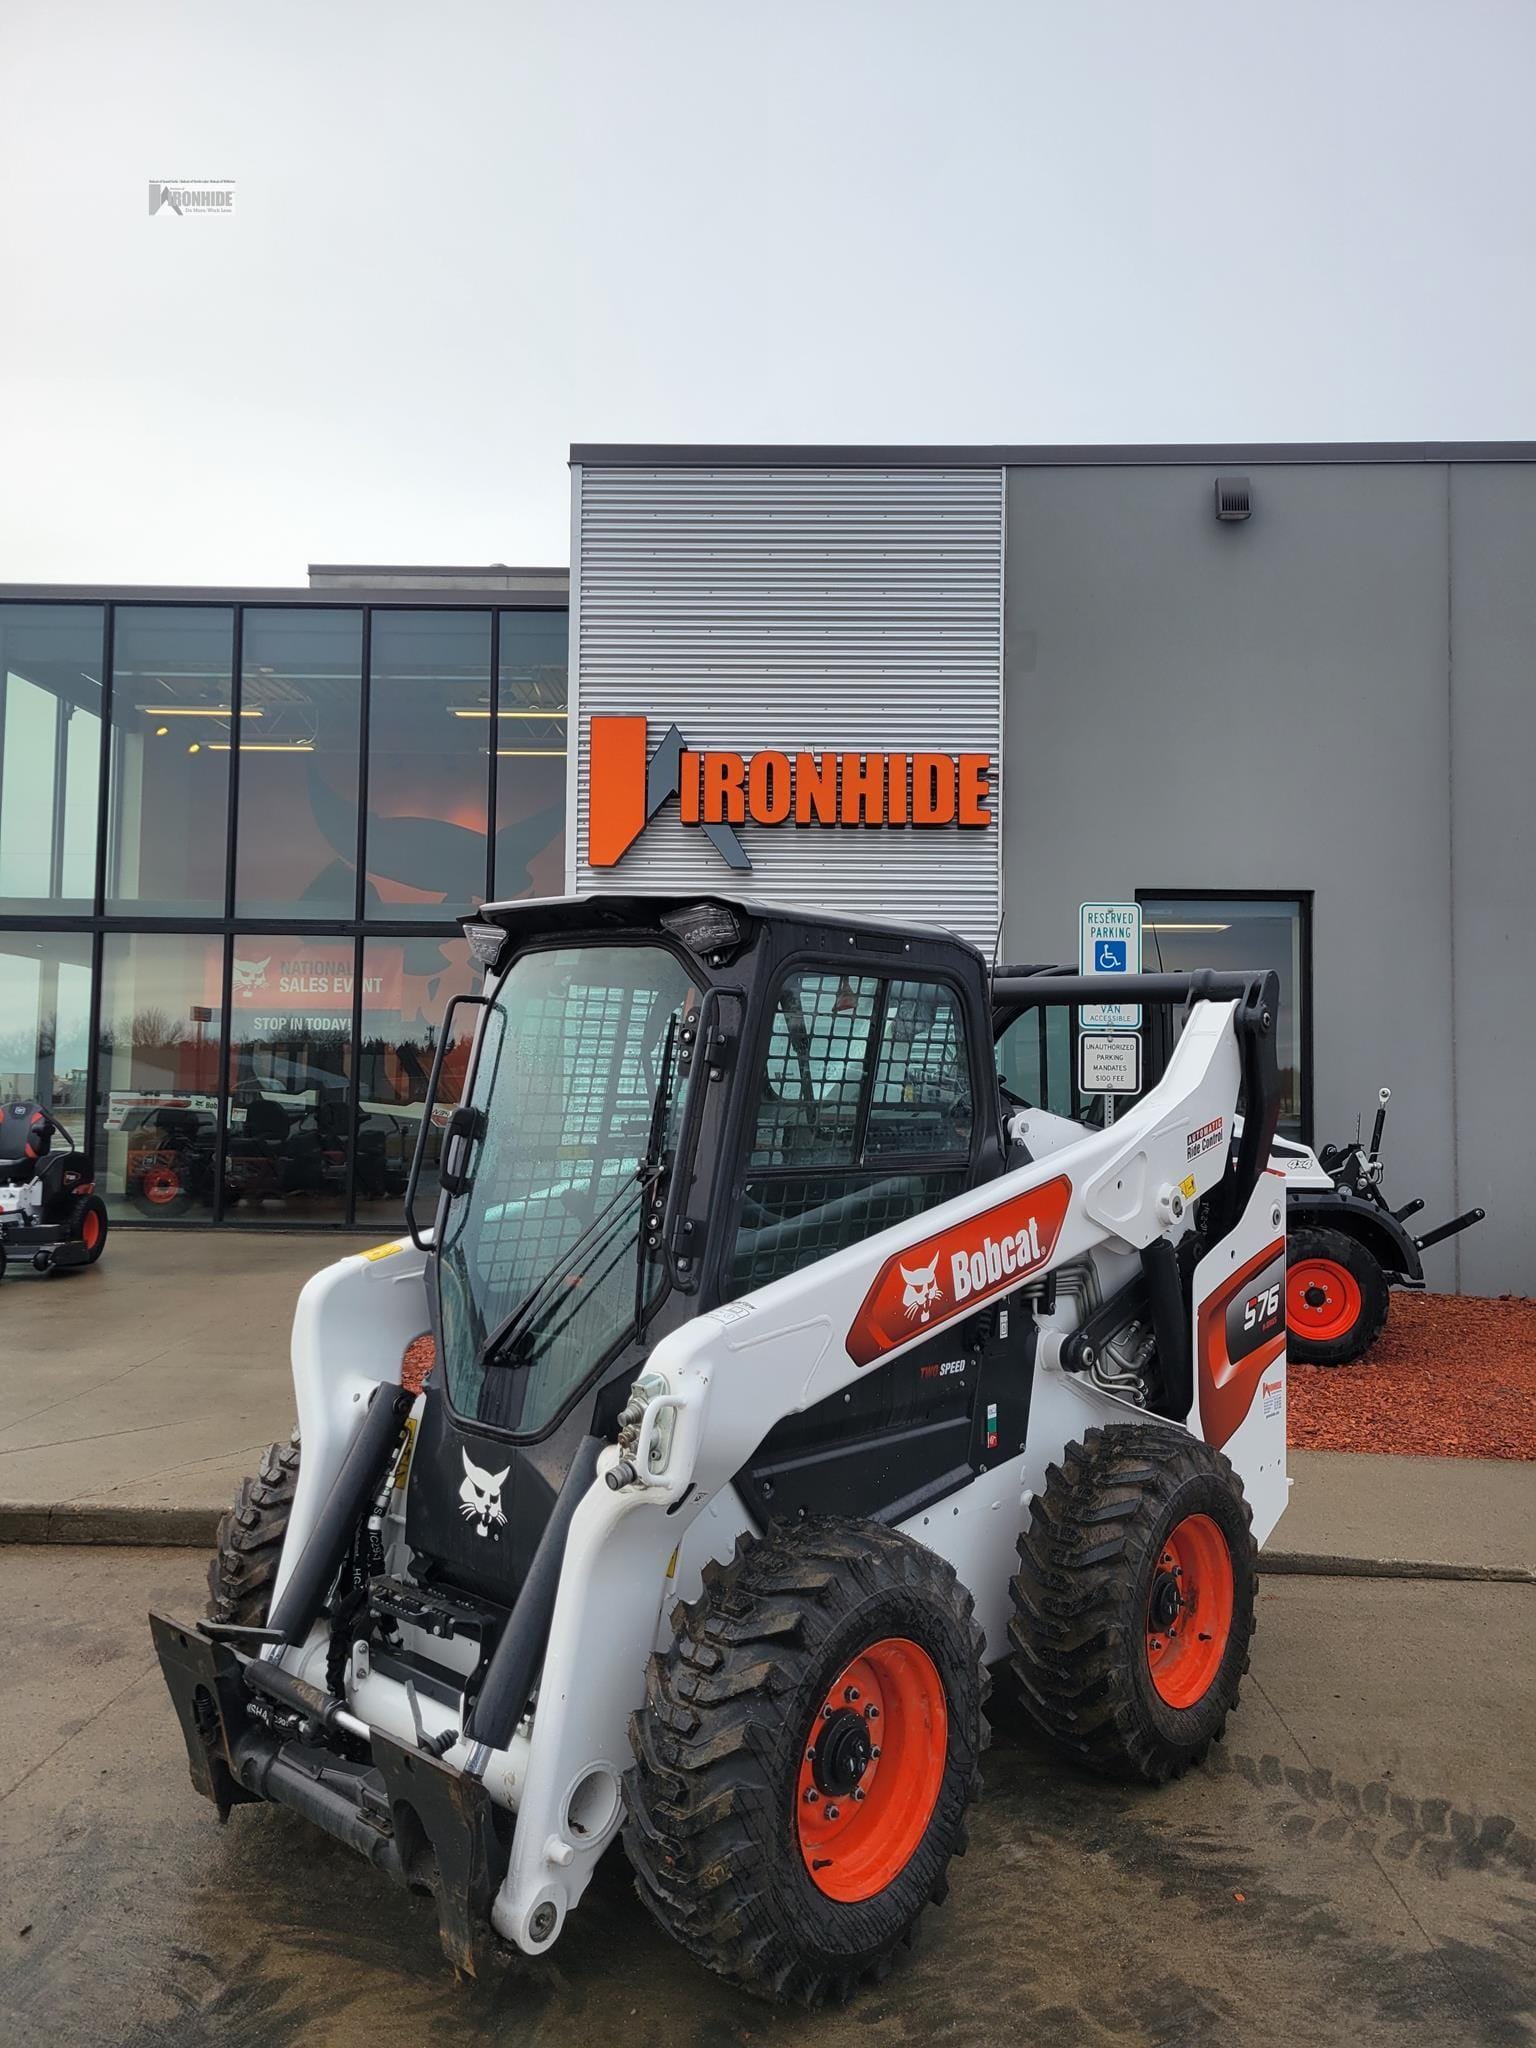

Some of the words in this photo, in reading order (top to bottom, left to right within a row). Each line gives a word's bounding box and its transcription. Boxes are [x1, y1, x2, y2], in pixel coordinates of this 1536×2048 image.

[680, 750, 992, 828] IRONHIDE
[1088, 912, 1134, 925] RESERVED
[1090, 927, 1131, 938] PARKING
[280, 961, 353, 976] NATIONAL
[279, 977, 329, 993] SALES
[333, 977, 383, 993] EVNT
[1100, 1005, 1121, 1014] VAN
[253, 1017, 287, 1031] STOP
[290, 1017, 303, 1030] IN
[305, 1017, 352, 1031] TODAY!
[1188, 1118, 1223, 1144] AUTOMATIC
[1186, 1142, 1201, 1160] Ride
[1202, 1128, 1223, 1152] Control
[951, 1216, 1041, 1302] Bobcat
[1243, 1282, 1280, 1331] S76
[920, 1364, 939, 1379] TWO
[939, 1359, 966, 1376] SPEED
